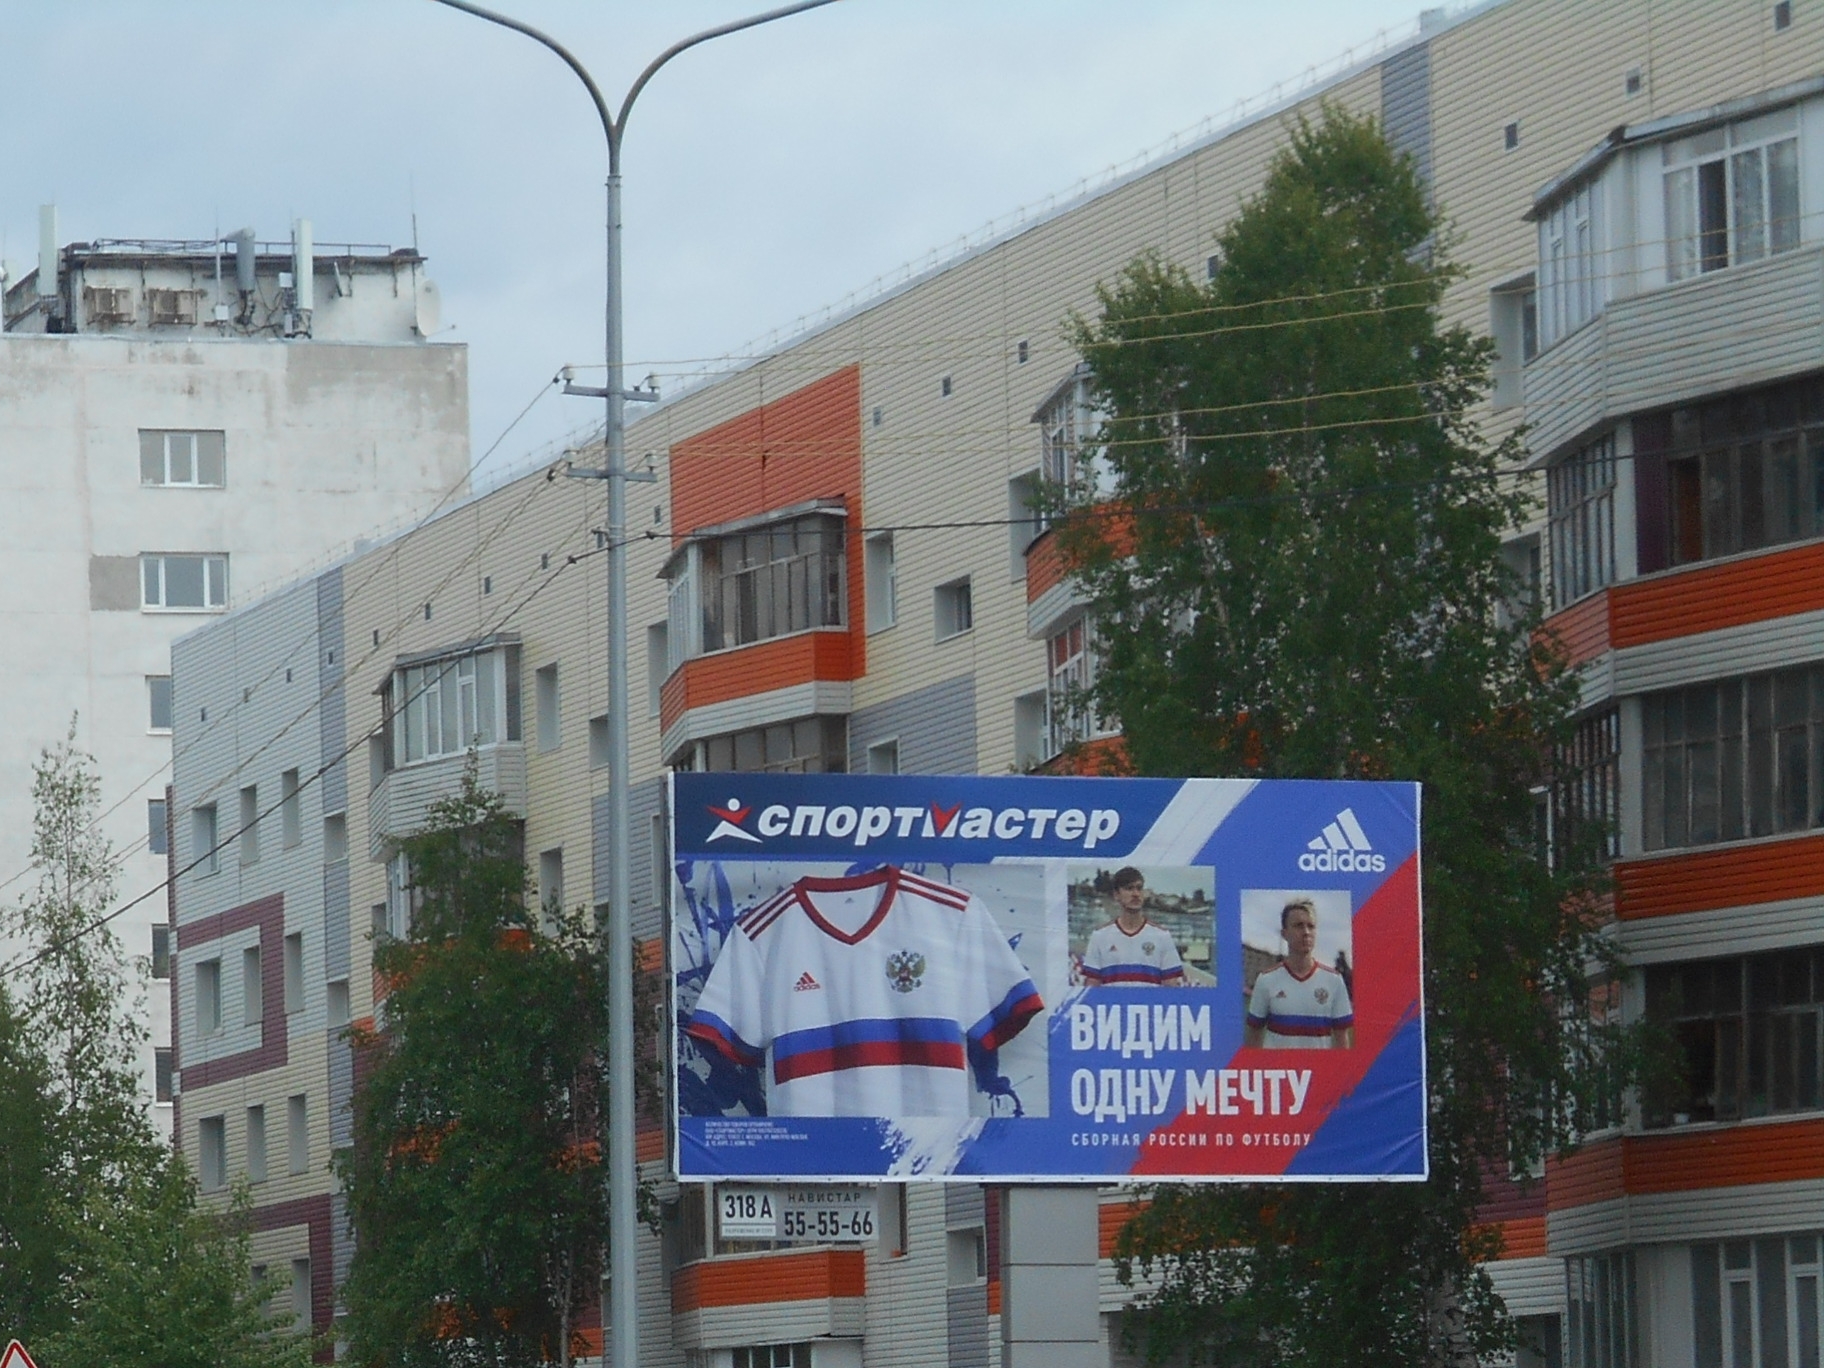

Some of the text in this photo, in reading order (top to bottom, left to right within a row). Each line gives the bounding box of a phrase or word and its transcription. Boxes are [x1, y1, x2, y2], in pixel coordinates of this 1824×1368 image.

[1298, 848, 1386, 873] adidas
[1071, 1004, 1211, 1058] ВИДИМ
[1071, 1068, 1312, 1123] ОДНУ МЕЧТУ
[1072, 1133, 1311, 1147] СБОРНАЯ РОССИИ ПО ФУТБОЛУ
[725, 1194, 756, 1218] 318
[787, 1192, 862, 1204] НАВИСТАР
[783, 1210, 873, 1237] 55-55-66
